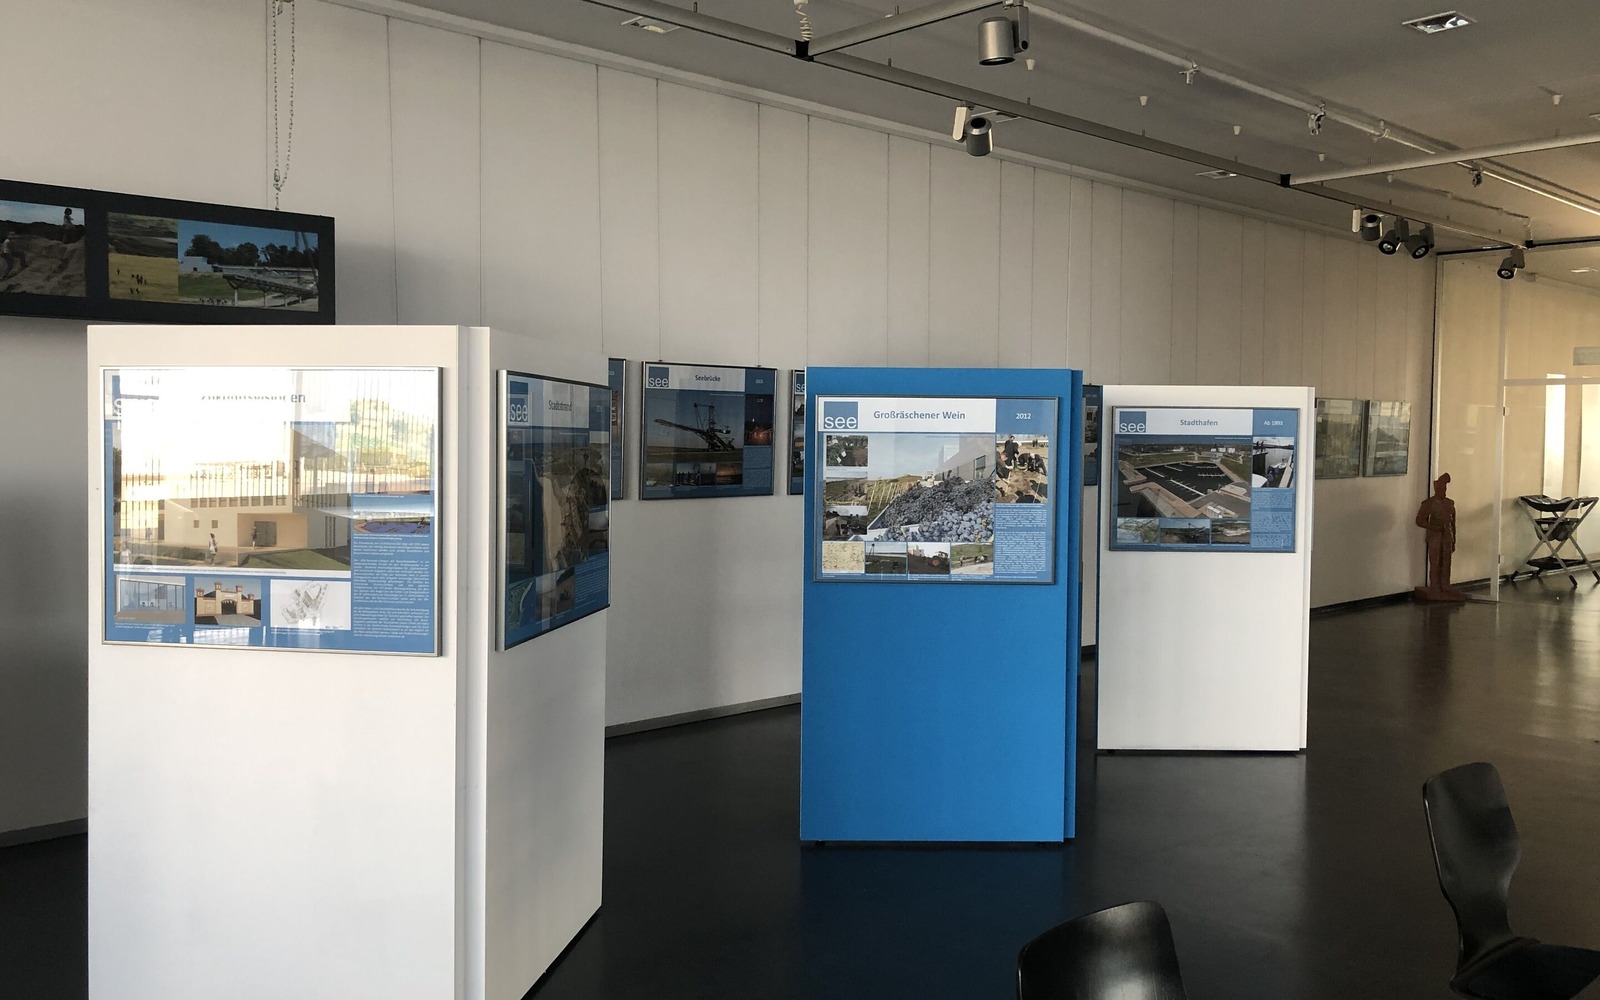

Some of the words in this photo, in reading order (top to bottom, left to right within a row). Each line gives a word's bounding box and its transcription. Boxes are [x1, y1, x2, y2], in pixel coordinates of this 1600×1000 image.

[648, 376, 669, 388] see
[694, 374, 721, 382] Seebrücke
[796, 383, 805, 392] se
[510, 404, 528, 421] see
[873, 410, 940, 420] Großräschener
[942, 411, 966, 420] Wein
[1015, 412, 1032, 420] 2012
[824, 416, 857, 429] see
[1119, 422, 1146, 433] see
[1179, 419, 1219, 427] Stadthafen
